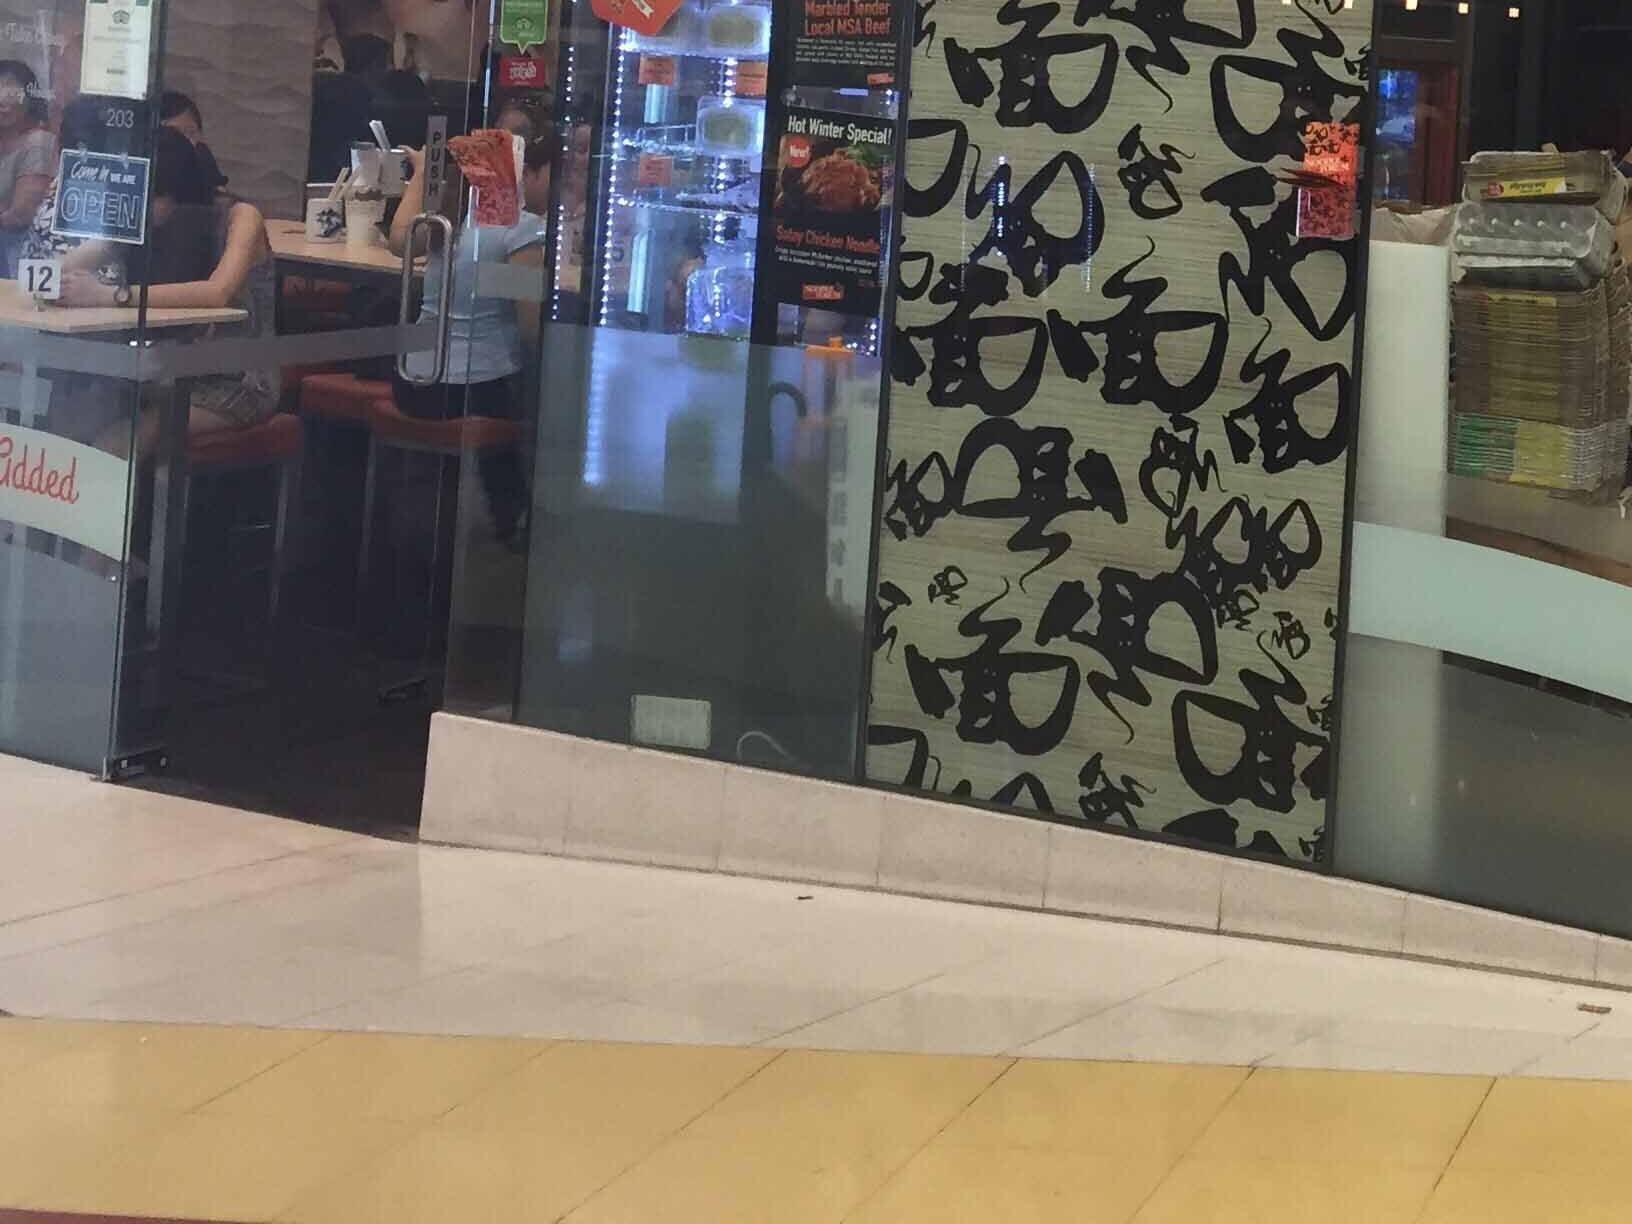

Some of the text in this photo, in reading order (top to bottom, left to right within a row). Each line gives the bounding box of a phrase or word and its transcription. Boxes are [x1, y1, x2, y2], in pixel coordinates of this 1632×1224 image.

[805, 0, 892, 17] Marbled Tender
[805, 17, 892, 36] Local MSA Beef
[105, 108, 134, 129] 203
[787, 115, 892, 145] Hot Winter Special!
[61, 187, 140, 229] OPEN
[26, 266, 53, 293] 12
